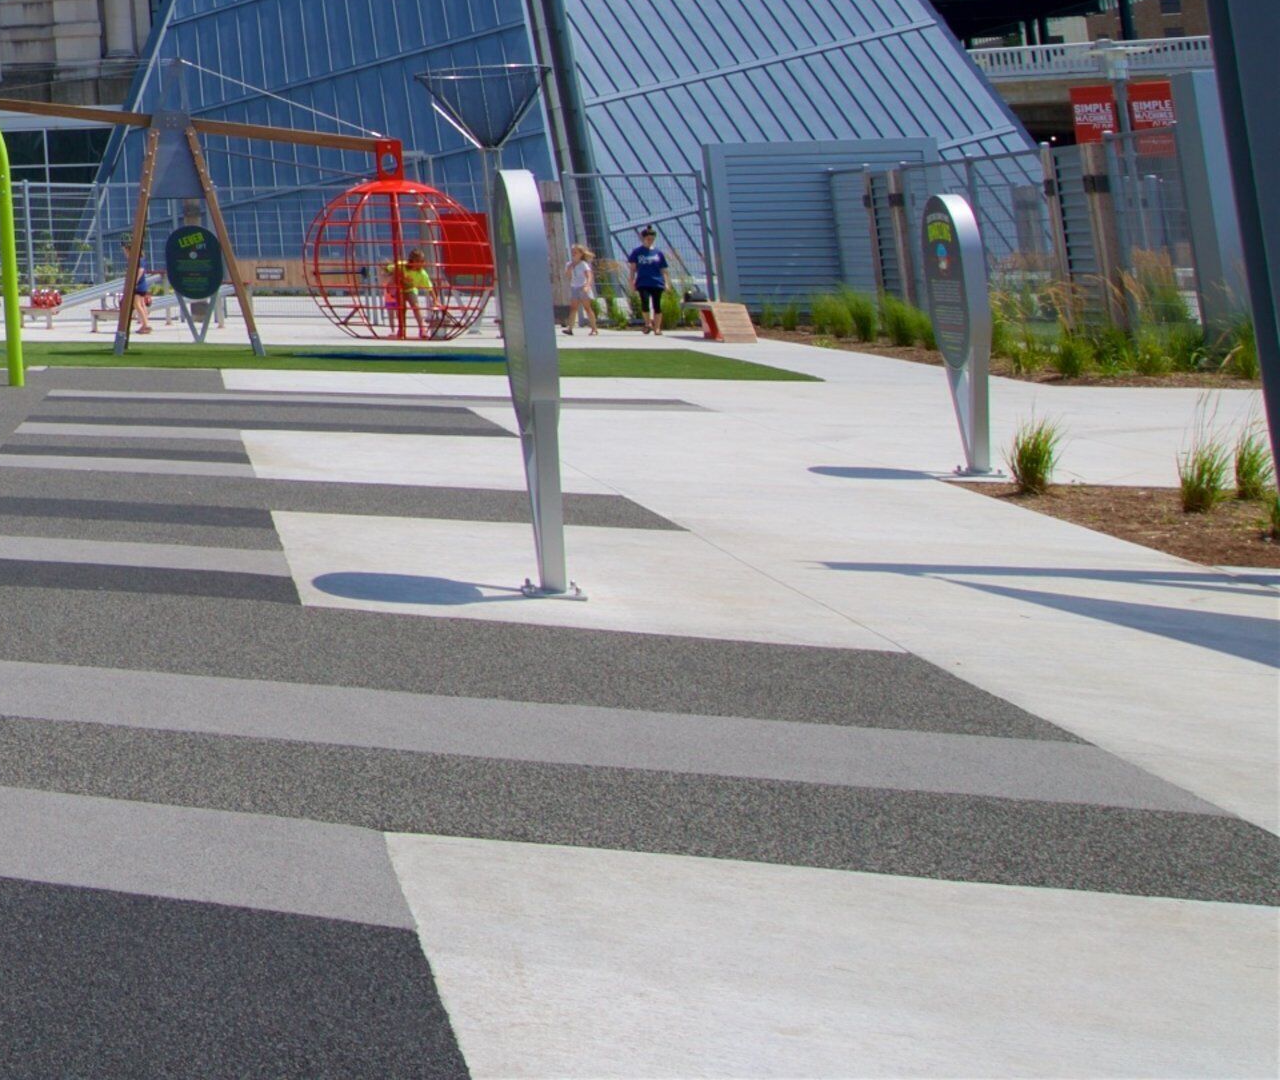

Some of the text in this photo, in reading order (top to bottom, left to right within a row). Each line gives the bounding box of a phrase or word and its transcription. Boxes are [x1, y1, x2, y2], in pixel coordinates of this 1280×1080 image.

[1074, 103, 1112, 113] SIMPLE
[1132, 100, 1172, 111] SIMPLE
[1075, 112, 1114, 123] MACHINES
[1134, 110, 1174, 122] MACHINES
[178, 232, 205, 248] LEVER
